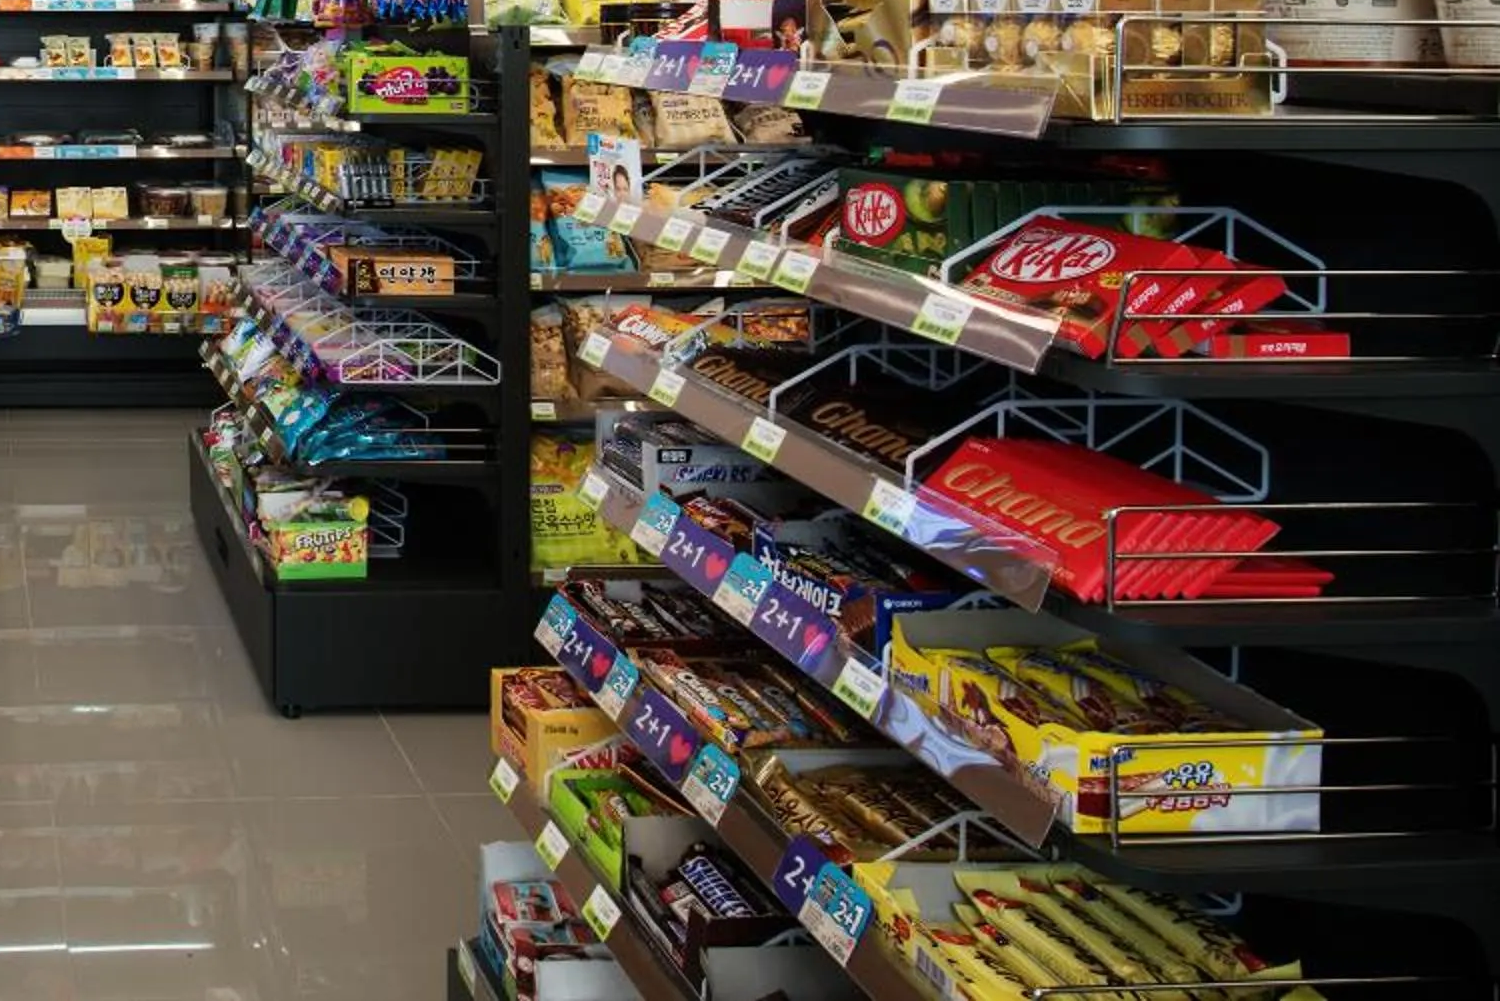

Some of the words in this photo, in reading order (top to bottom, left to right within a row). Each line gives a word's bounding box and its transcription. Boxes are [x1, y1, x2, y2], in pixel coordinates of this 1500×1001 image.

[654, 54, 686, 77] 2+1
[728, 64, 765, 88] 2+1
[854, 194, 891, 234] KitKat
[1003, 235, 1104, 279] KitKat
[694, 355, 770, 403] Ghan
[944, 462, 1105, 548] Ghana
[669, 532, 705, 567] 2+1
[761, 598, 803, 640] 2+1
[563, 631, 593, 667] 2+1
[635, 704, 672, 747] 2+1
[709, 772, 735, 800] 2+1
[833, 901, 865, 936] 2+1
